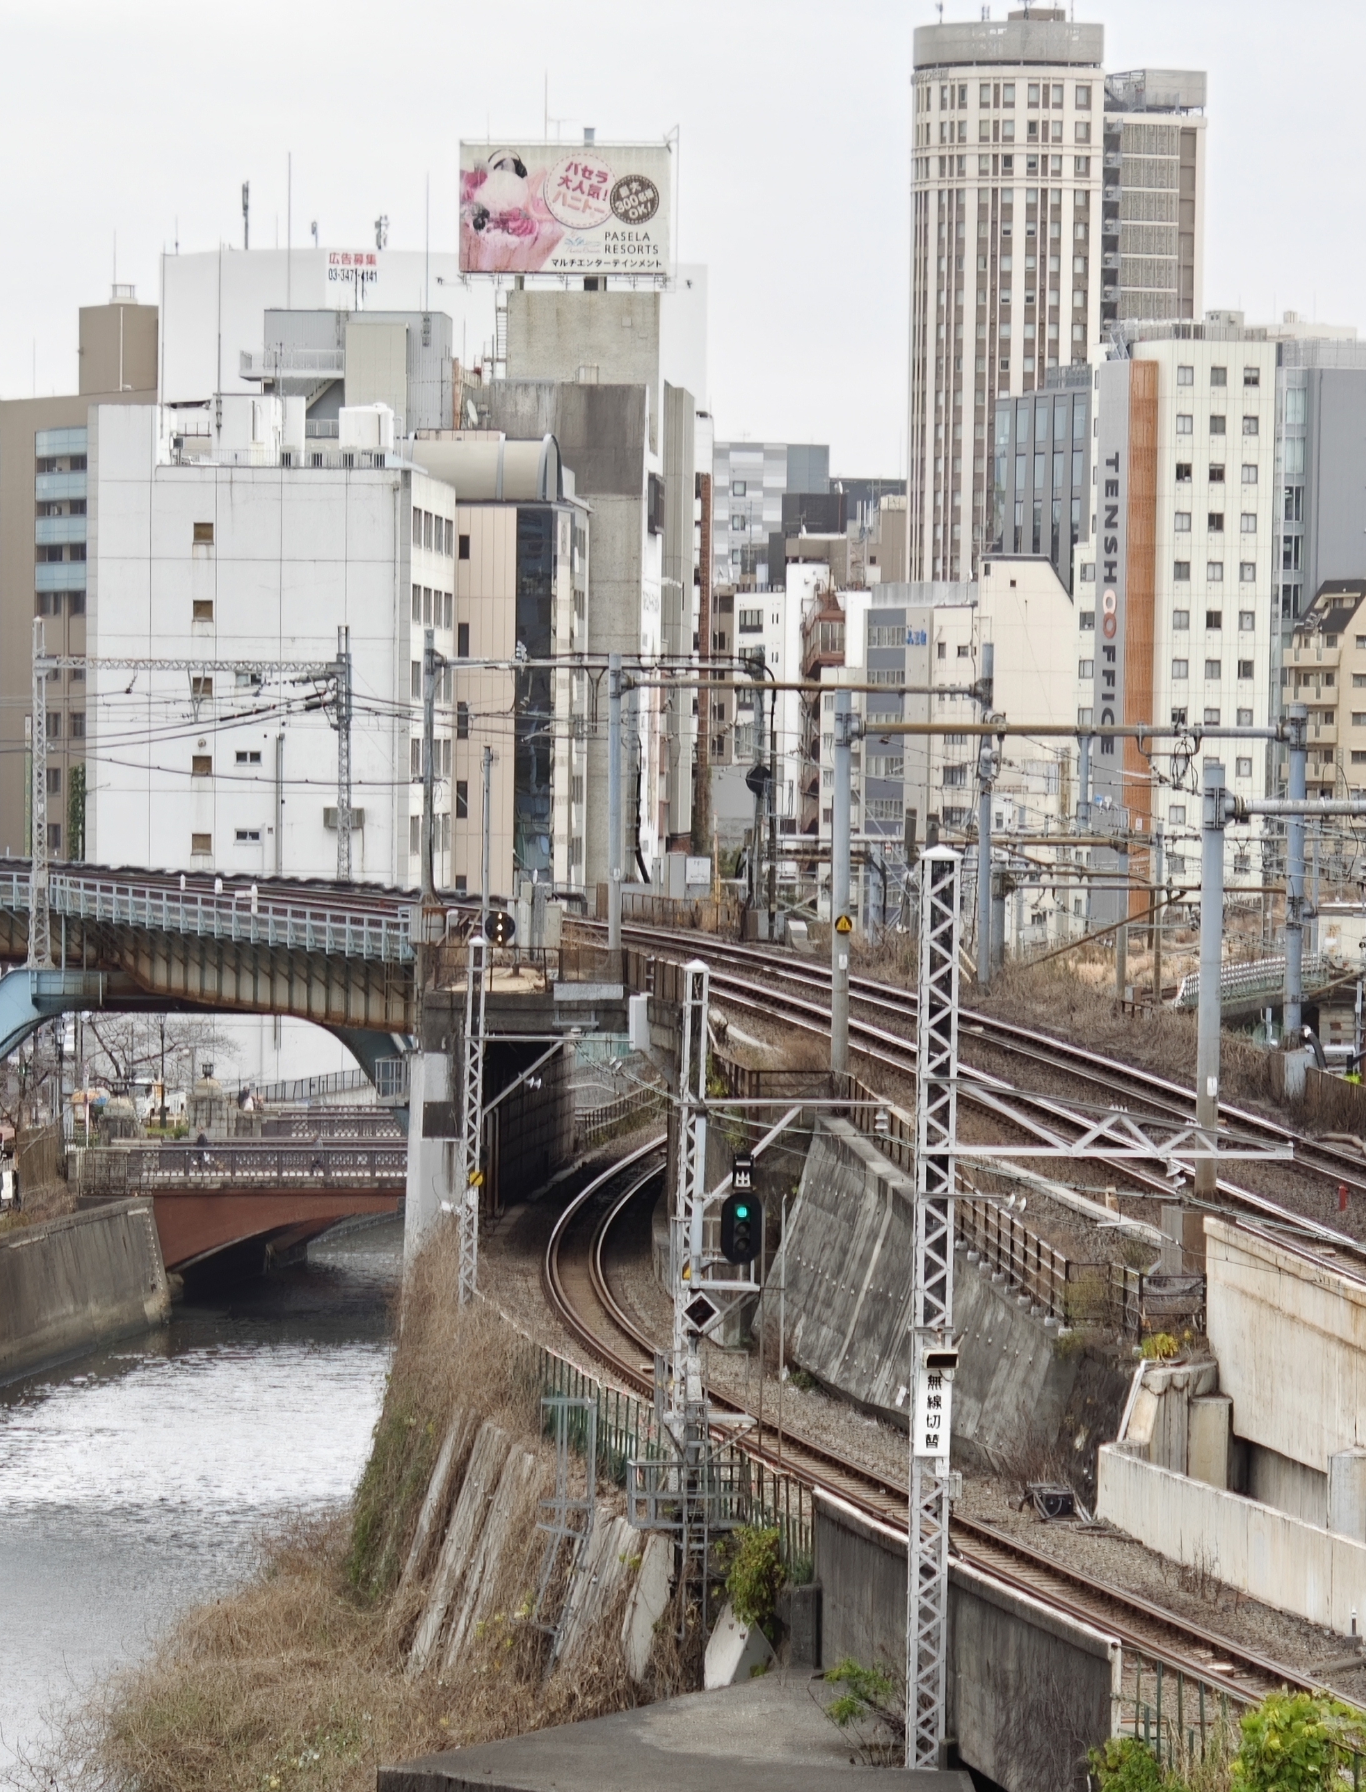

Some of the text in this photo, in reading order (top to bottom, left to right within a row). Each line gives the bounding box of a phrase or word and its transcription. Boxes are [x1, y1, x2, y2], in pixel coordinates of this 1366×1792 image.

[604, 231, 651, 242] PASELA
[604, 244, 659, 255] RESORTS
[329, 252, 377, 266] 広告募集
[551, 258, 663, 268] マルチエンターテインメント
[925, 1374, 943, 1450] 無線切替
